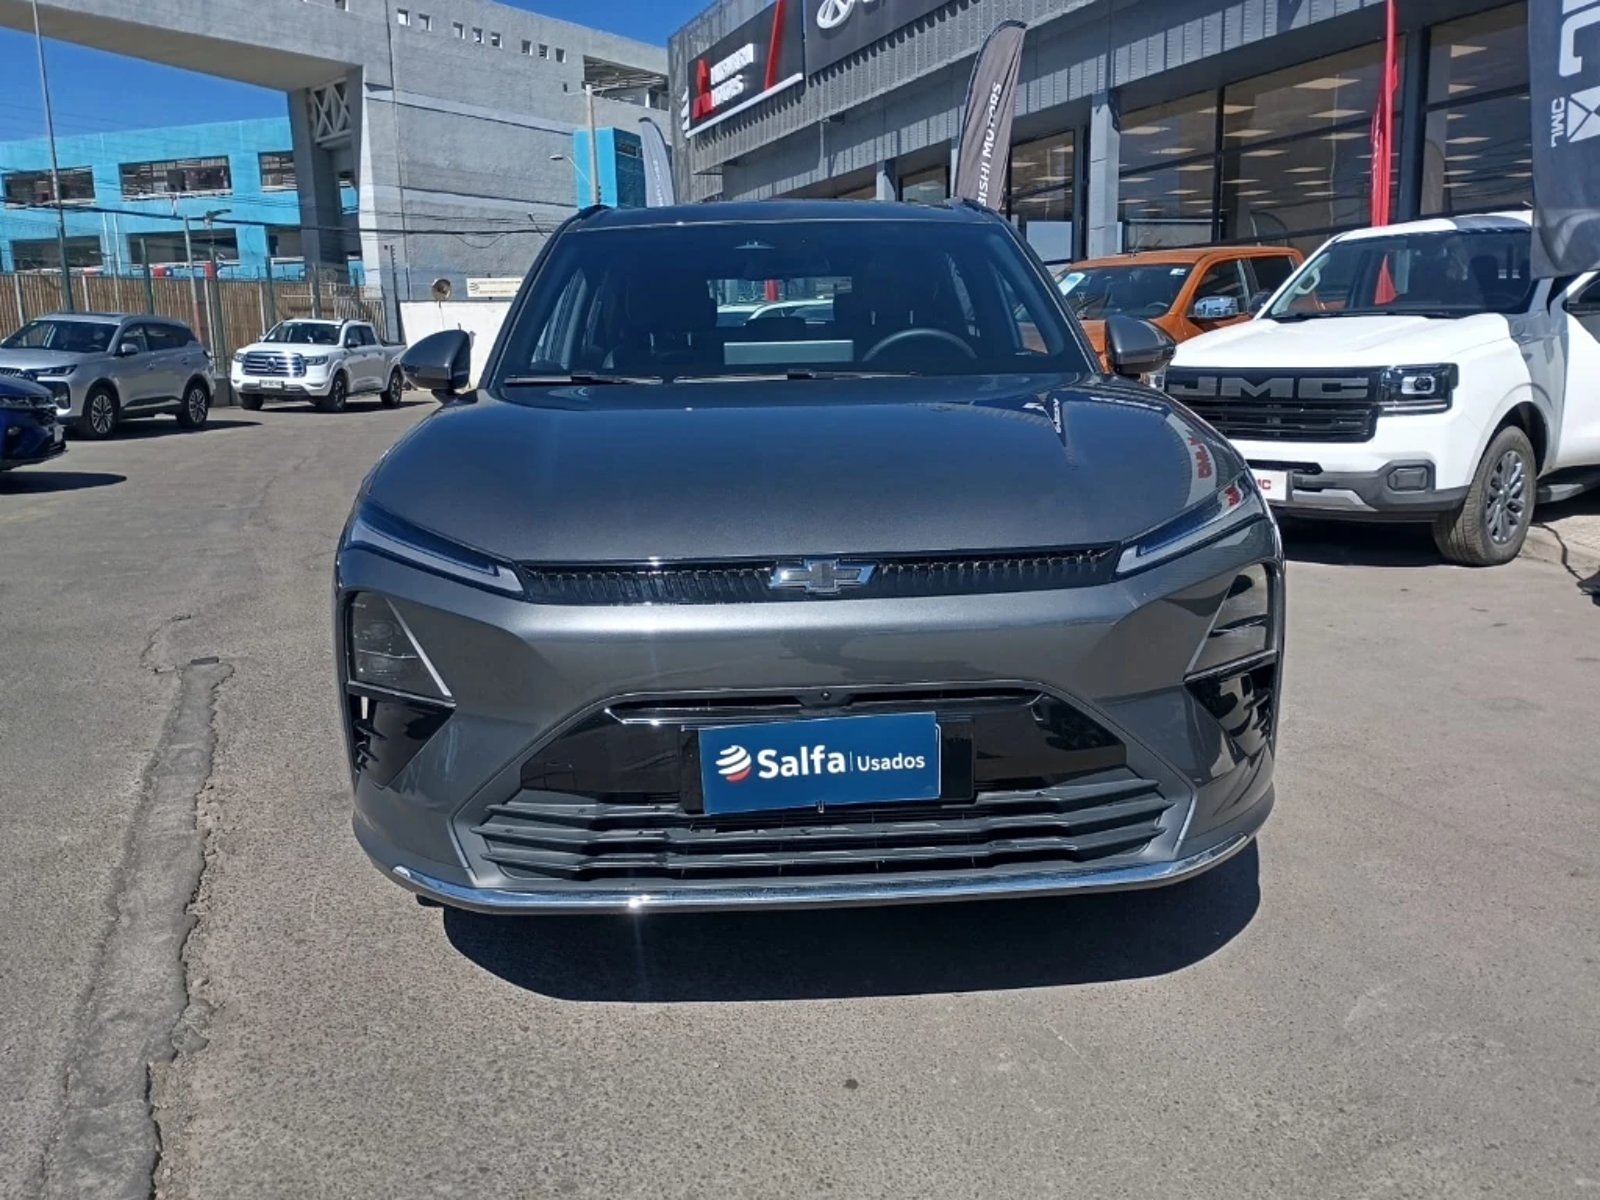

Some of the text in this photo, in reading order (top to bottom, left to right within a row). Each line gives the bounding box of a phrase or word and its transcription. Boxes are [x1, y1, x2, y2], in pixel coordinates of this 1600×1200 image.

[1168, 376, 1369, 398] JMC
[757, 744, 926, 779] Salfa Usados
